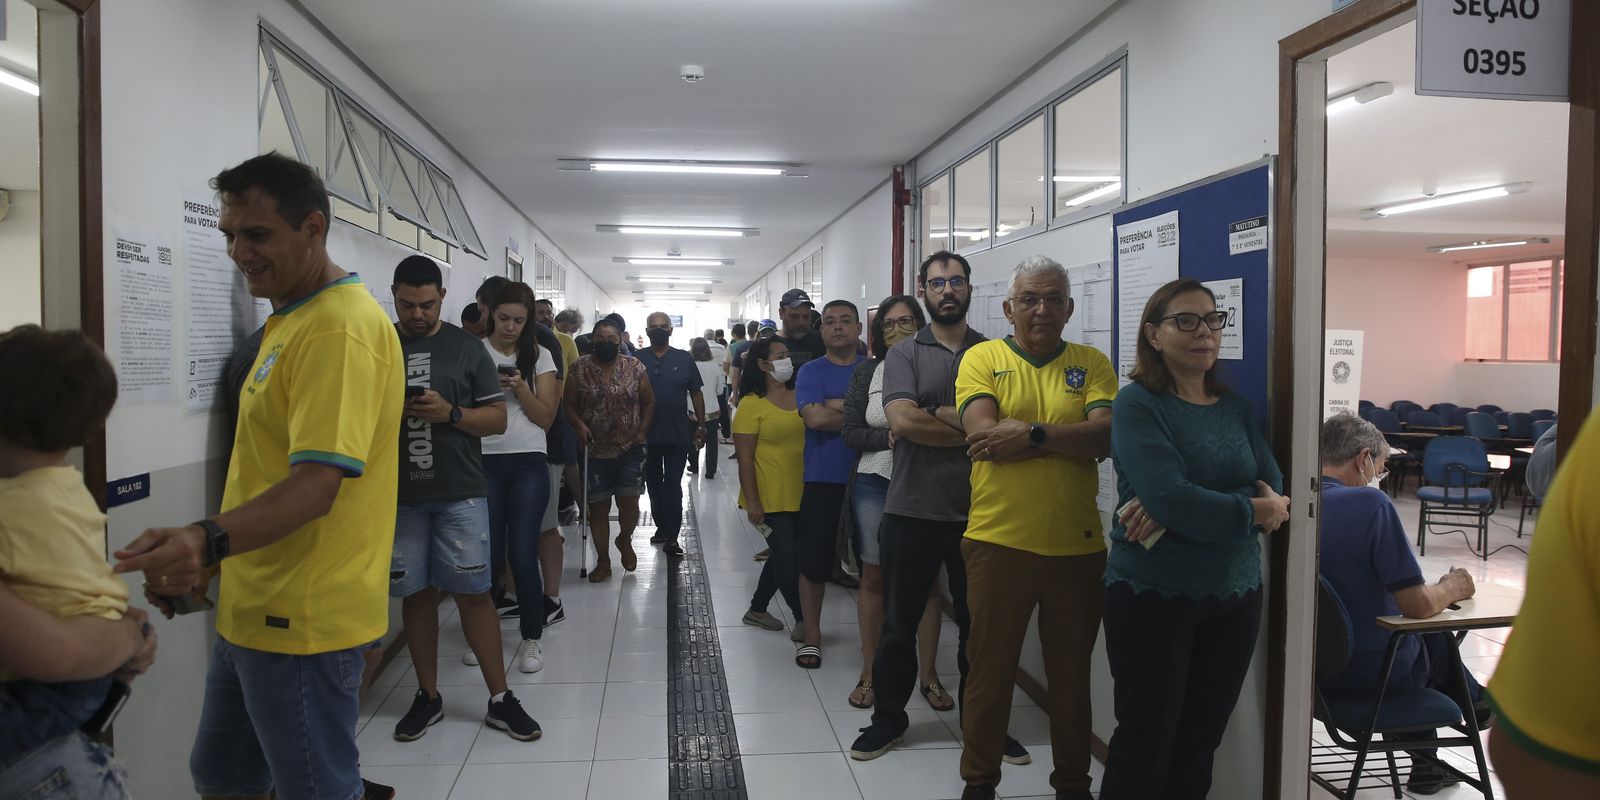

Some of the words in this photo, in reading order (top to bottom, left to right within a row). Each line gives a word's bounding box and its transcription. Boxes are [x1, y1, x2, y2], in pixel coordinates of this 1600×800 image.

[1463, 48, 1526, 76] 0395
[184, 200, 220, 218] PREFERÊNC
[184, 215, 197, 225] PARA
[198, 217, 217, 229] VOTAR
[1235, 219, 1260, 231] MATUTINO
[1120, 230, 1153, 245] PREFERÊNCIA
[1130, 243, 1145, 253] VOTAR
[117, 251, 150, 264] RESPEITADAS
[1333, 340, 1353, 348] JUSTIÇA
[1330, 348, 1355, 356] ELEITORAL
[408, 352, 431, 390] NEV
[118, 483, 132, 494] SALA
